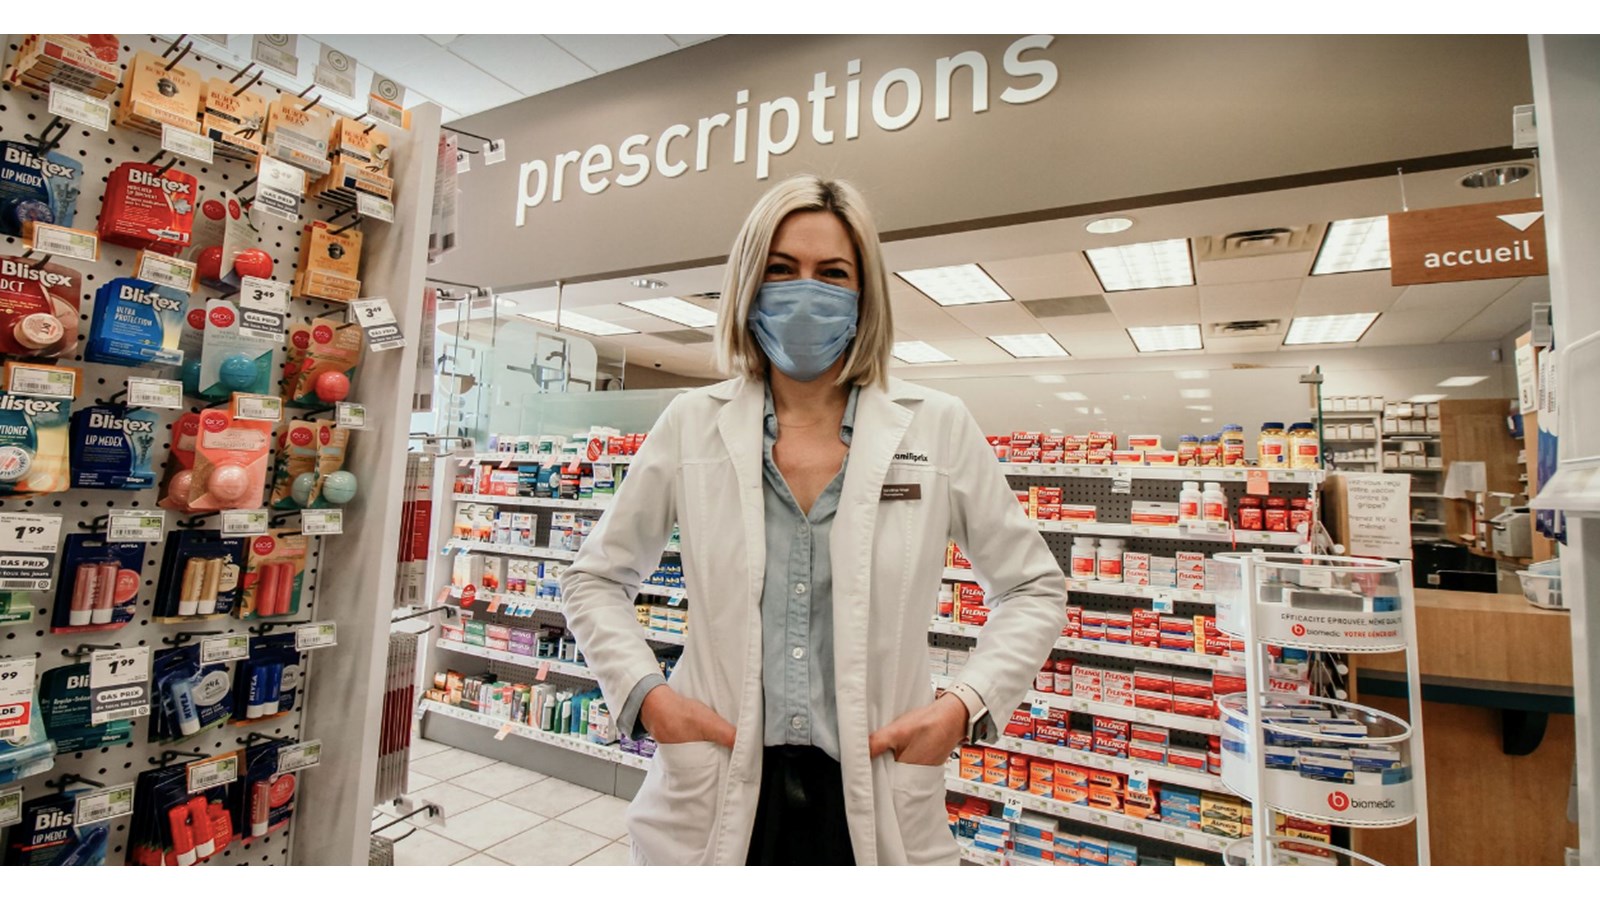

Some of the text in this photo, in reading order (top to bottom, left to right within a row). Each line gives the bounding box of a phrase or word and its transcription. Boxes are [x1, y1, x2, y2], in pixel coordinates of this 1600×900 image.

[515, 34, 1058, 227] prescriptions
[5, 147, 76, 180] Blistex
[1, 166, 43, 188] LIP MEDEX
[128, 168, 191, 195] Blistex
[1424, 240, 1533, 268] accueil
[1, 261, 72, 288] Blistex
[1, 279, 25, 293] DCT
[119, 285, 181, 313] Blistex
[117, 306, 136, 316] ULTRA
[115, 313, 153, 327] PROTECTION
[89, 413, 153, 435] Blistex
[205, 418, 225, 426] eos
[85, 434, 124, 448] LIP MEDEX
[1013, 433, 1040, 441] TYLENOL
[893, 452, 928, 462] amiliprix
[1013, 449, 1040, 457] TYLENOL
[255, 541, 273, 549] eos
[1306, 628, 1341, 637] biomedic
[1075, 667, 1101, 677] TYLENOL
[1268, 679, 1299, 692] TYLEN
[100, 690, 140, 701] BAS PRIX
[1036, 725, 1065, 738] TYLENOL
[1096, 720, 1126, 732] TYLENOL
[1096, 737, 1126, 749] TYLENOL
[1351, 798, 1396, 809] biomedic
[35, 811, 74, 831] Blis
[32, 829, 68, 845] LIP MEDEX
